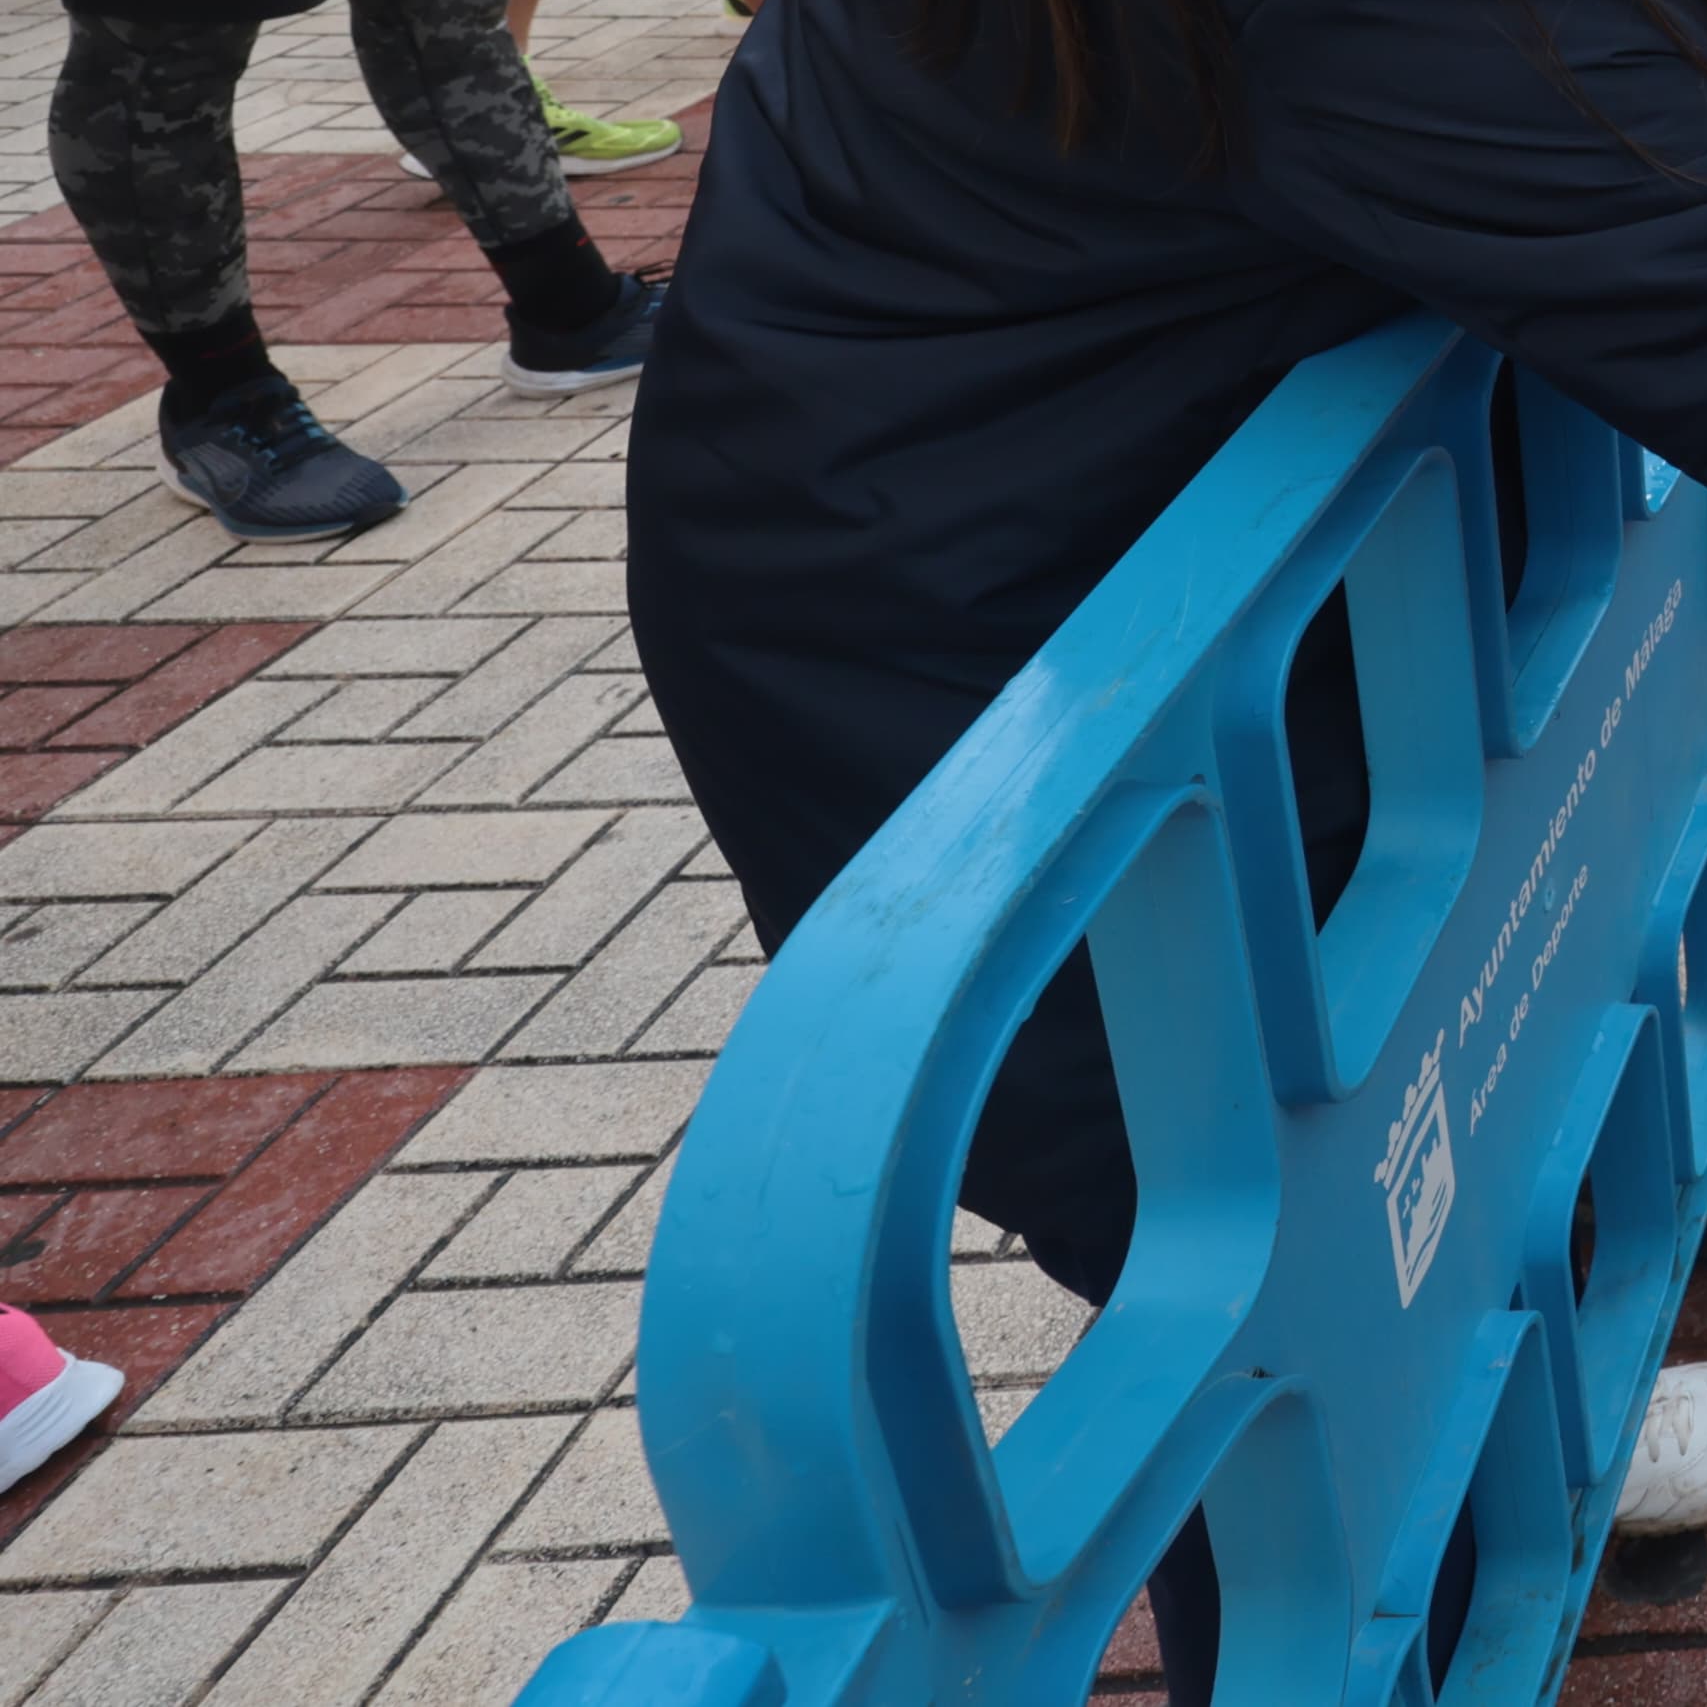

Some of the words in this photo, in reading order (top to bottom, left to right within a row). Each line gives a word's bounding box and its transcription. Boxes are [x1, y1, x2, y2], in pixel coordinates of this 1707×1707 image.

[1458, 749, 1596, 1050] Ayuntamiento
[1600, 696, 1622, 749] de
[1624, 578, 1683, 701] Málaga
[1469, 1041, 1508, 1138] Área
[1509, 992, 1530, 1042] de
[1531, 863, 1589, 992] Deporte
